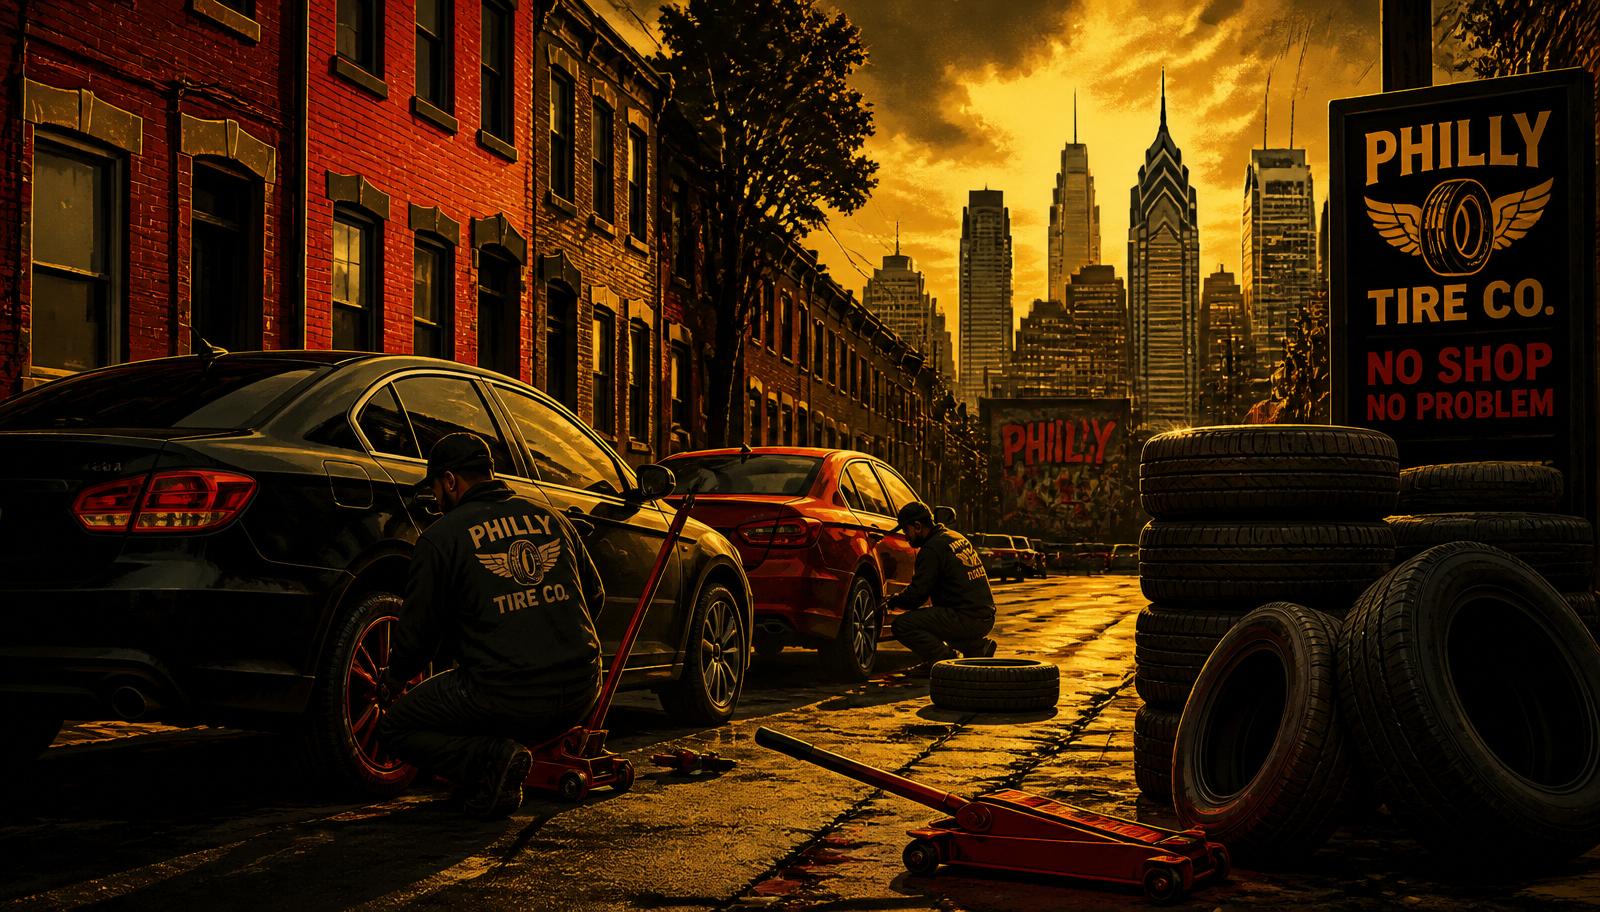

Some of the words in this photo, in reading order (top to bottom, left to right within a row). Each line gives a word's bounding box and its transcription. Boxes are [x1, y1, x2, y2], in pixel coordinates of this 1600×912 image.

[1365, 110, 1552, 186] PHILLY
[1367, 283, 1468, 326] TIRE
[1483, 278, 1554, 319] CO.
[1367, 348, 1423, 386] NO
[1438, 342, 1553, 384] SHOP
[1367, 393, 1406, 421] NO
[1417, 388, 1553, 420] PROBLEM
[468, 514, 552, 549] PHILLY
[493, 588, 539, 614] TIRE
[542, 584, 570, 604] CO.
